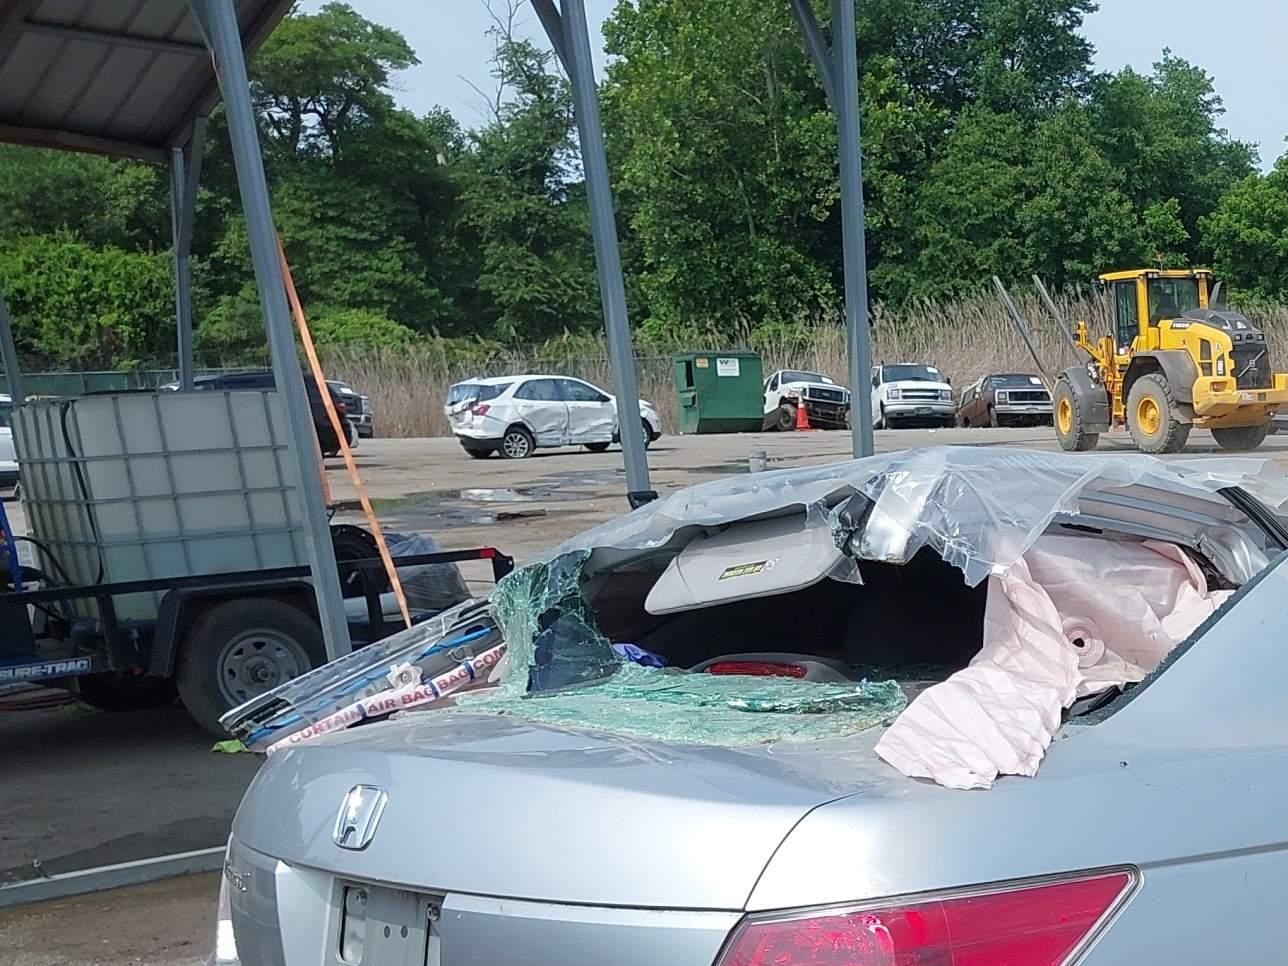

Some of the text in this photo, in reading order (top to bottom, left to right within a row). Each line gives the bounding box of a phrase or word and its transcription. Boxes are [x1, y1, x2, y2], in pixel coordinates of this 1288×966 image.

[289, 708, 361, 743] CURTAIN
[367, 699, 396, 714] AIR
[401, 687, 433, 704] BAG
[437, 669, 469, 689] BAG
